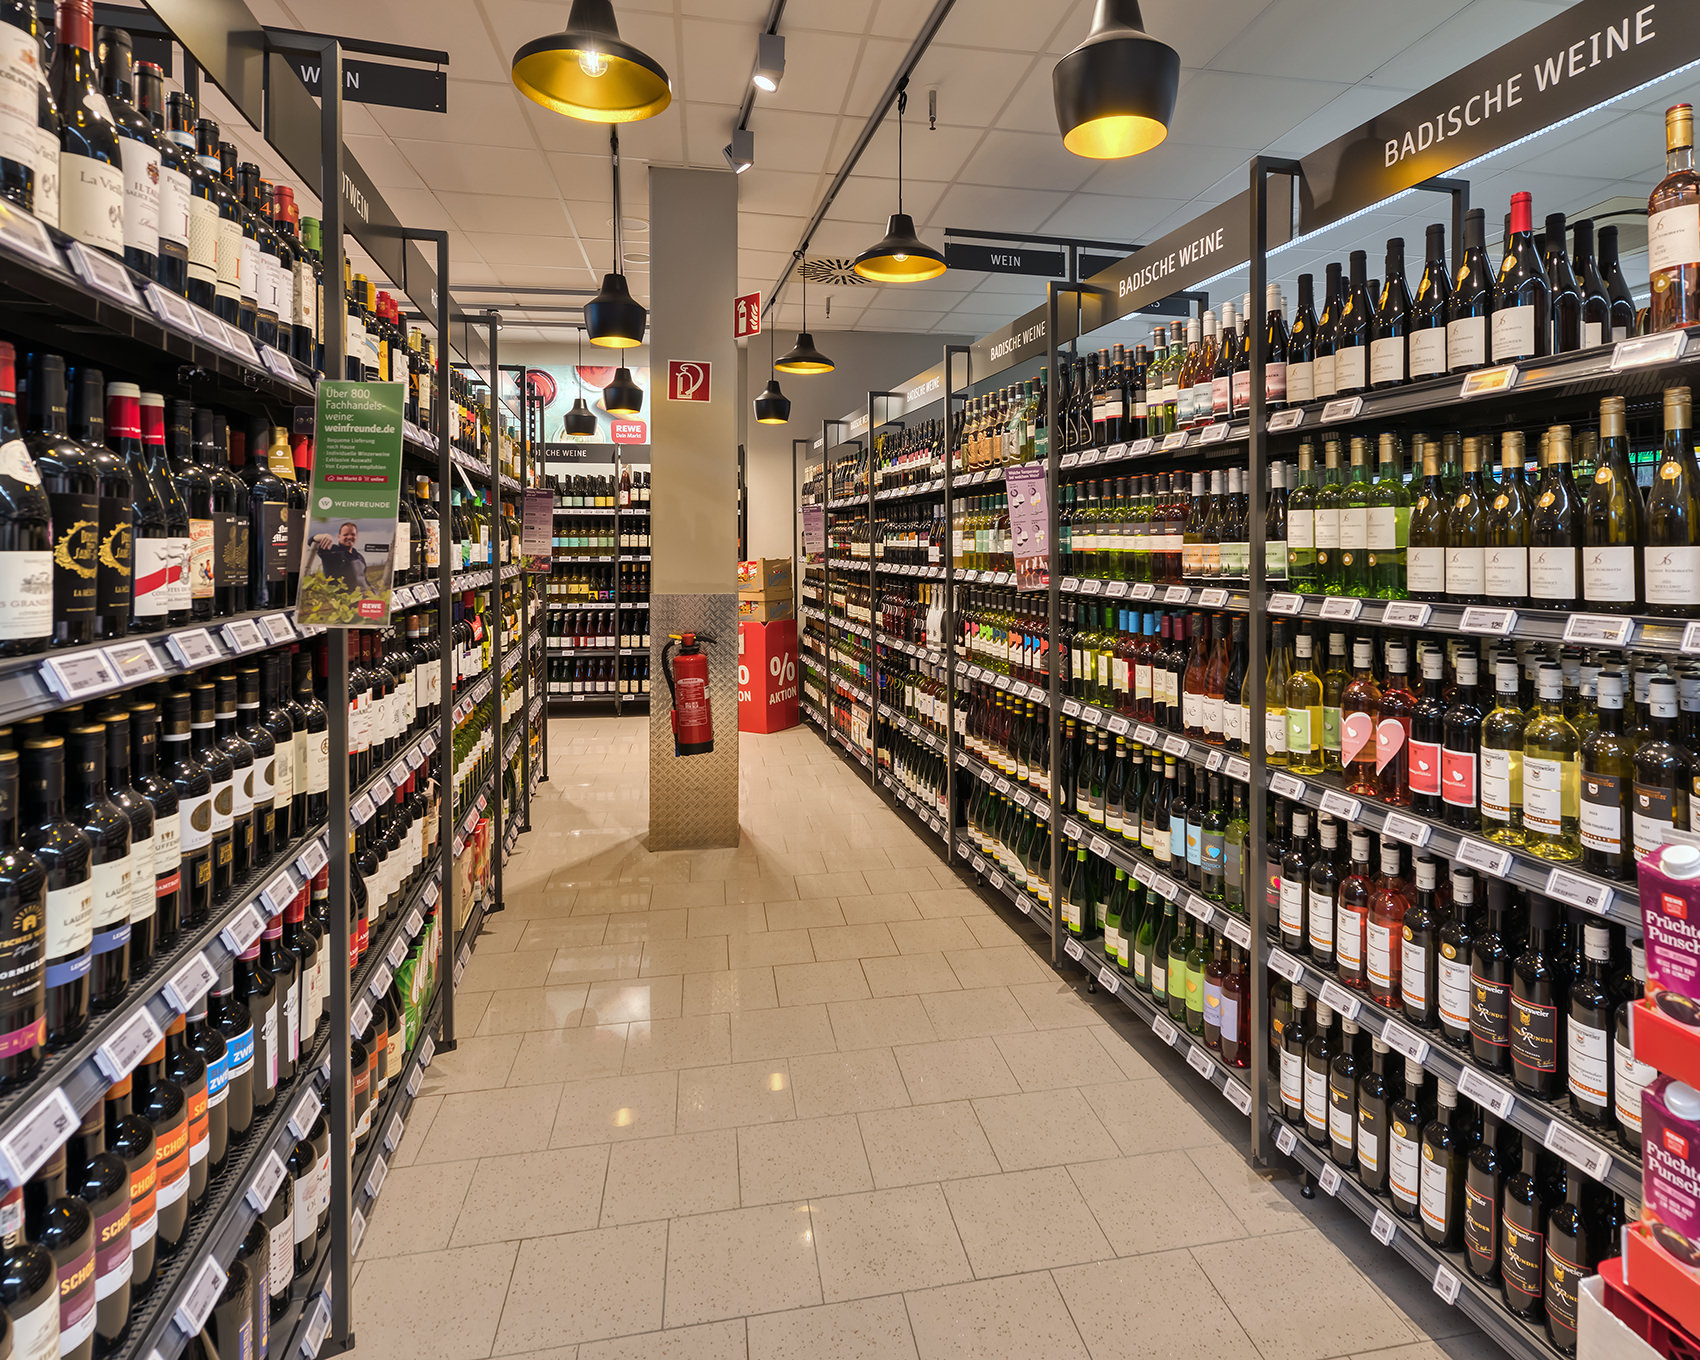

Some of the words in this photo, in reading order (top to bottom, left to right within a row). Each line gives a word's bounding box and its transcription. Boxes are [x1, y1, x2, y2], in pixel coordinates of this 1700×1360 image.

[301, 65, 360, 90] WN
[1385, 73, 1522, 167] BADISCHE
[1534, 4, 1655, 92] WEINE
[990, 253, 1021, 267] WEIN
[1119, 252, 1176, 298] BADISCHE
[1179, 227, 1224, 269] WEINE
[990, 334, 1022, 361] BADISCHE
[1023, 320, 1046, 348] WEINE
[326, 386, 348, 398] Über
[350, 388, 371, 399] 800
[325, 400, 386, 411] Fachhandels-
[325, 411, 354, 421] weine:
[324, 423, 395, 434] weinfreunde.de
[616, 425, 642, 433] REWE
[562, 449, 587, 458] WEINE
[769, 685, 797, 706] AKTION
